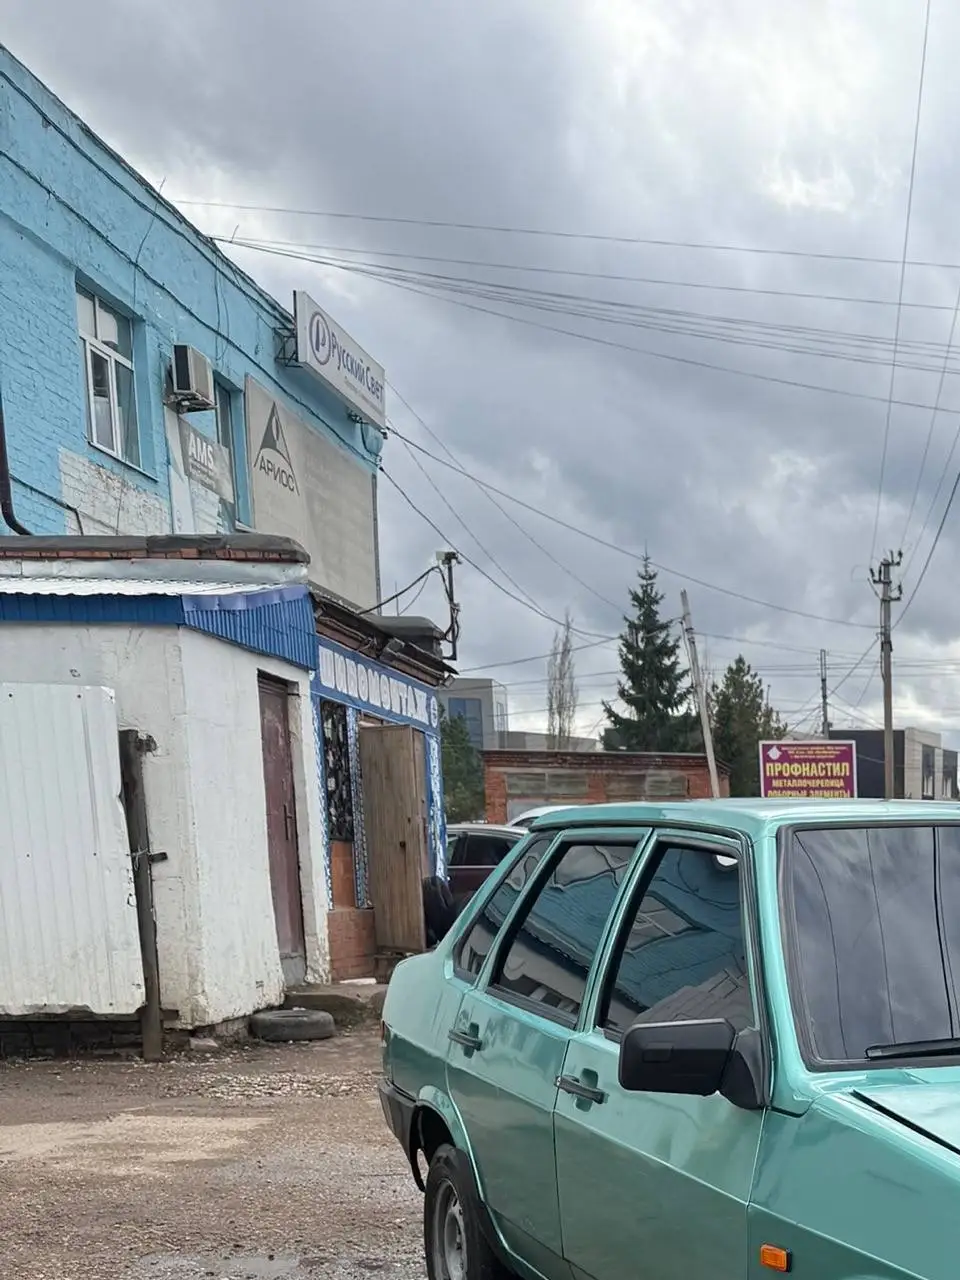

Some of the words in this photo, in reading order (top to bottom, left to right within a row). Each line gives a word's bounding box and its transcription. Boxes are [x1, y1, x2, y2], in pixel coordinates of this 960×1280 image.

[331, 331, 366, 387] Русский
[365, 366, 384, 404] Свет
[766, 762, 850, 777] ПРОФНАСТИЛ
[772, 779, 845, 788] МЕТАЛЛОЧЕРЕПИЦА
